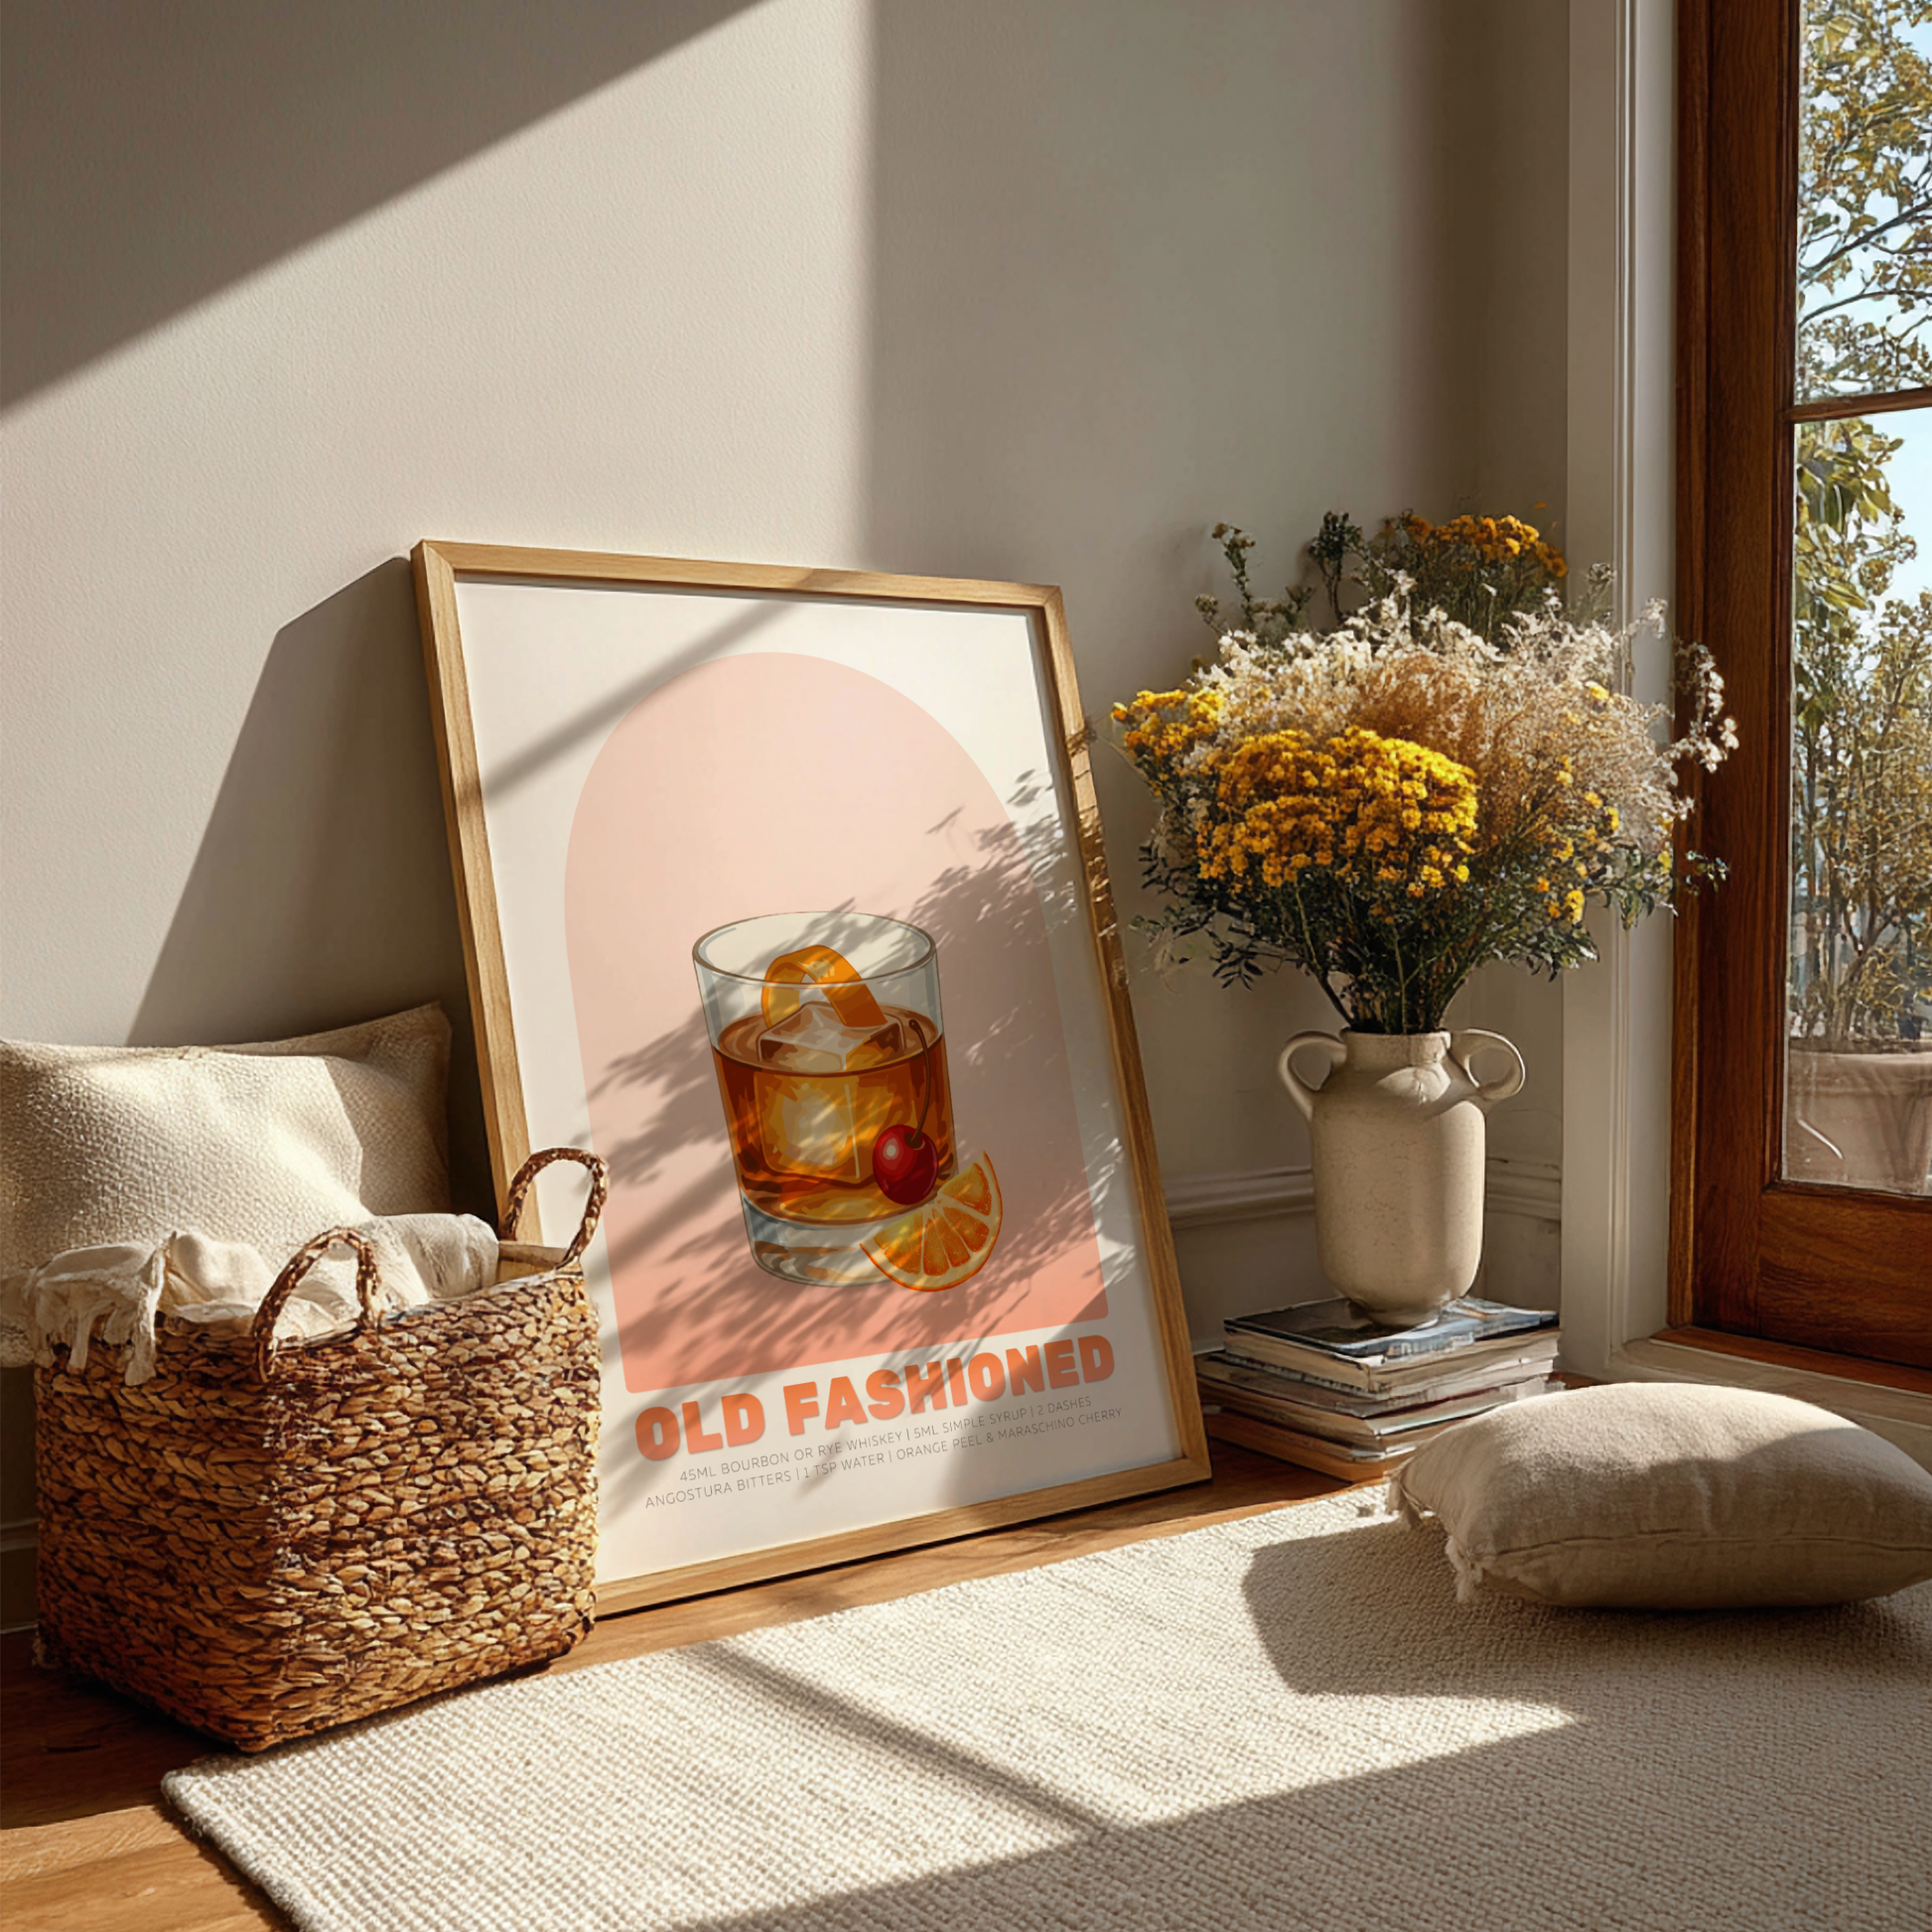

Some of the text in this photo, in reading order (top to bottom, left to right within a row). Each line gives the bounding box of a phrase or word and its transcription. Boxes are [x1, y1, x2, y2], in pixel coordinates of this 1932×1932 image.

[634, 1334, 1115, 1460] OLD FASHIONED
[680, 1466, 717, 1481] 45ML
[721, 1452, 789, 1474] BOURBON
[794, 1448, 813, 1460] OR
[818, 1442, 842, 1456] RYE
[846, 1431, 901, 1450] WHISKEY
[914, 1425, 938, 1439] 5ML
[942, 1416, 985, 1433] SIMPLE
[989, 1408, 1027, 1425] SYRUP
[1037, 1404, 1043, 1416] 2
[1047, 1396, 1092, 1414] DASHES
[645, 1482, 733, 1509] ANGOSTURA
[737, 1470, 792, 1491] BITTERS
[804, 1467, 810, 1478] 1
[815, 1461, 837, 1476] TSP
[841, 1453, 885, 1470] WATER
[897, 1441, 949, 1460] ORANGE
[953, 1435, 983, 1449] PEEL
[986, 1432, 994, 1443] &
[998, 1418, 1074, 1441] MARASCHINO
[1078, 1407, 1122, 1425] CHERRY
